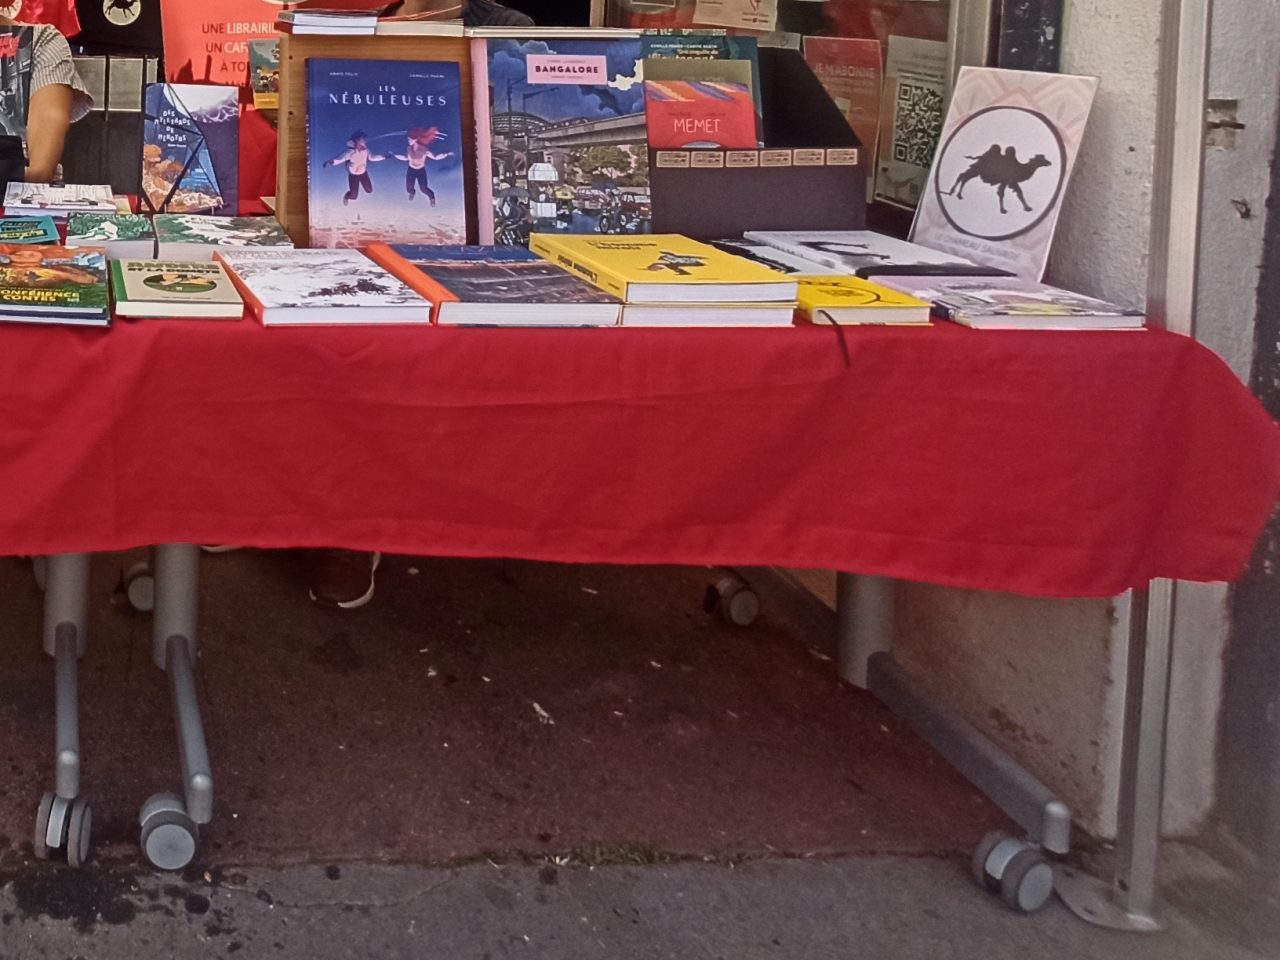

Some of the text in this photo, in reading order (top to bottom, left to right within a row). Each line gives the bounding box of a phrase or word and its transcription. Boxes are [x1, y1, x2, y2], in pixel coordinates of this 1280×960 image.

[202, 23, 224, 34] UNE
[206, 41, 248, 53] UN CAF
[535, 65, 599, 74] BANGALORE
[329, 91, 447, 107] NÉBULEUSES
[673, 118, 721, 134] MEMET
[3, 294, 57, 302] CONTES
